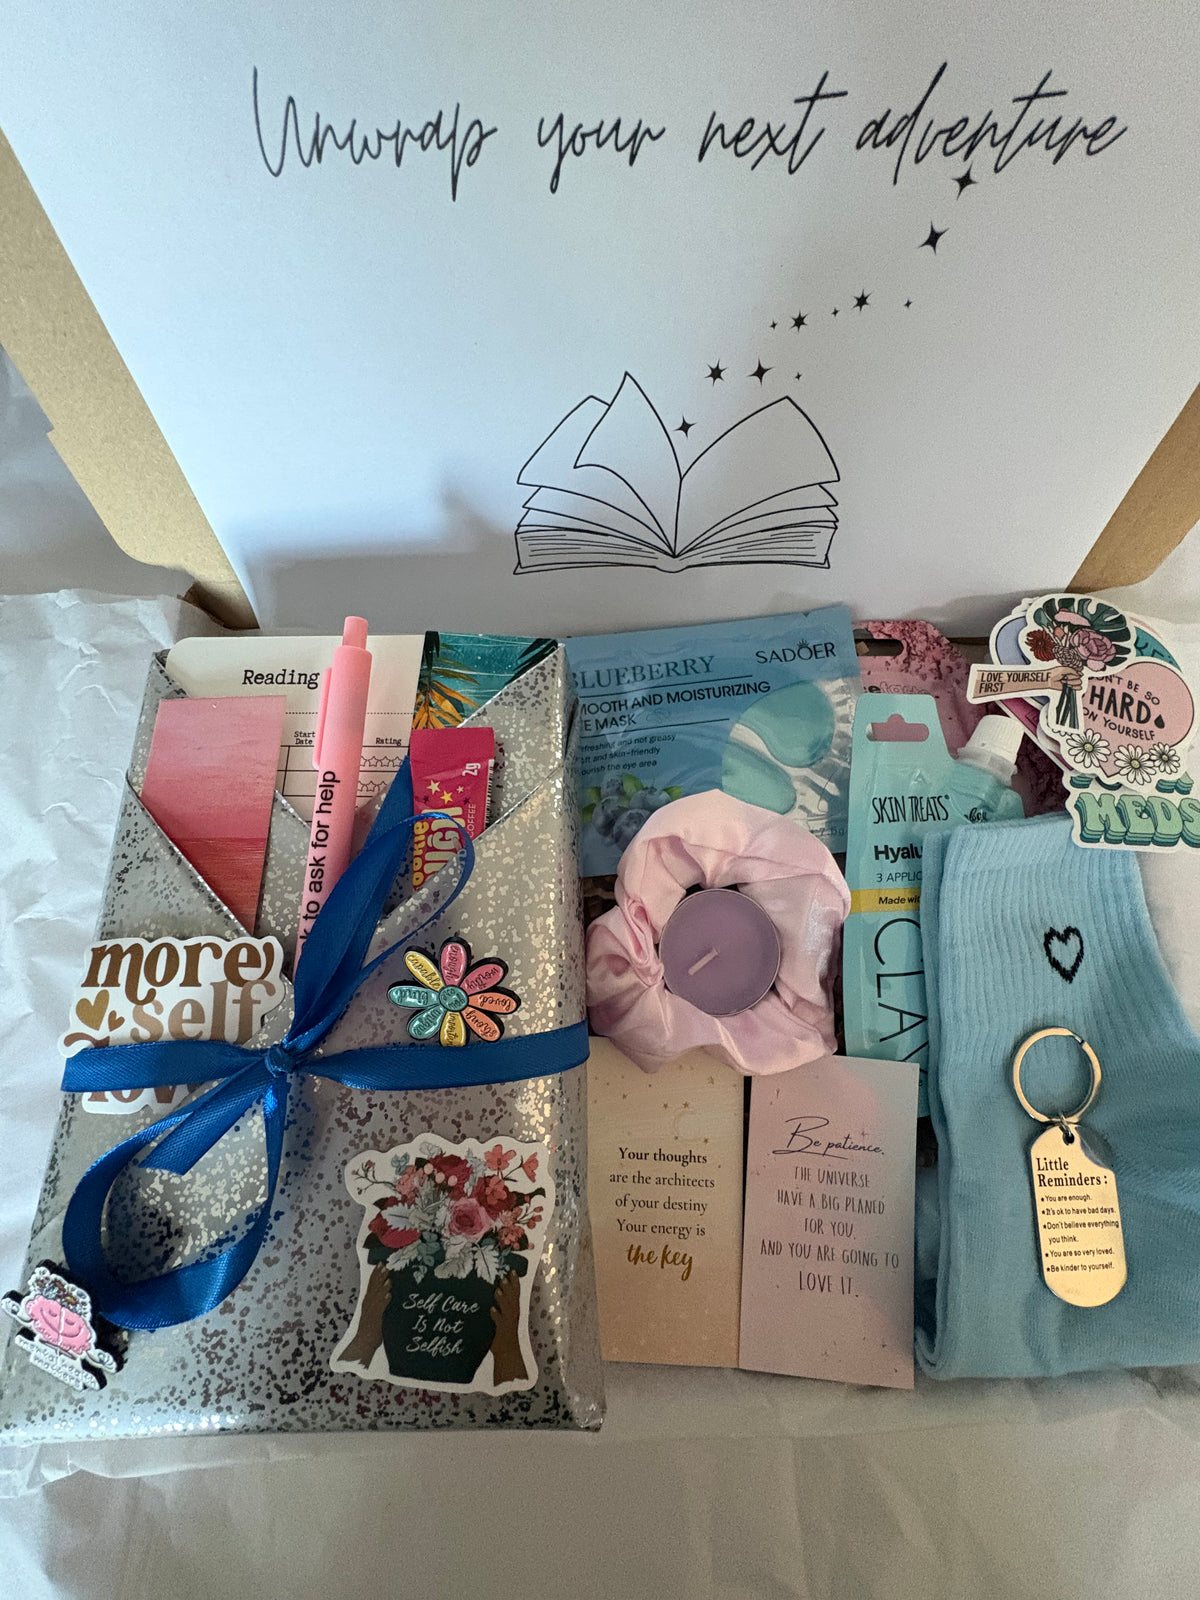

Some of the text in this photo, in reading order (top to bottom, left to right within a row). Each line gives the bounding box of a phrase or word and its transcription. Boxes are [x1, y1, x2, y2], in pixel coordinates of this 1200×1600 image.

[253, 61, 1128, 202] Unwrap your next adventure
[755, 641, 837, 664] SADOER
[242, 669, 320, 690] Reading
[980, 671, 1051, 683] LOVE YOURSELF
[631, 693, 663, 709] AND
[667, 681, 771, 703] MOISTURIZING
[979, 682, 1005, 694] FIRST
[1127, 680, 1139, 693] BE
[1144, 691, 1160, 705] SO
[1089, 685, 1151, 724] HARD
[595, 713, 637, 731] MASK
[1103, 716, 1155, 741] YOURSELF
[375, 737, 402, 746] Rating
[462, 763, 481, 777] 2g
[316, 770, 341, 814] help
[872, 796, 906, 824] SKIN
[311, 820, 330, 850] for
[874, 843, 922, 863] Hyalu
[309, 855, 326, 893] ask
[876, 872, 883, 883] 3
[302, 900, 320, 920] to
[878, 896, 906, 905] Made
[80, 941, 275, 1006] more
[129, 978, 277, 1045] self
[479, 995, 511, 1011] loved
[772, 1116, 832, 1158] Be
[619, 1147, 708, 1168] Your thoughts
[1036, 1157, 1069, 1171] Little
[609, 1171, 715, 1188] are the architects
[794, 1166, 871, 1188] THE UNIVERSE
[615, 1193, 708, 1216] of your destiny
[777, 1189, 885, 1215] HAVE A BIG PLANED
[1072, 1207, 1087, 1215] have
[617, 1218, 706, 1240] Your energy is
[804, 1217, 824, 1235] FOR
[1047, 1219, 1119, 1230] Don't believe everything
[1049, 1237, 1060, 1245] you
[626, 1243, 693, 1281] the key
[760, 1239, 899, 1269] AND YOU ARE GOING TO
[1061, 1263, 1080, 1271] kinder
[1081, 1263, 1087, 1271] to
[799, 1271, 833, 1293] LOVE
[402, 1293, 480, 1313] Self Care
[412, 1314, 464, 1333] Is Not
[405, 1335, 463, 1357] Selfish
